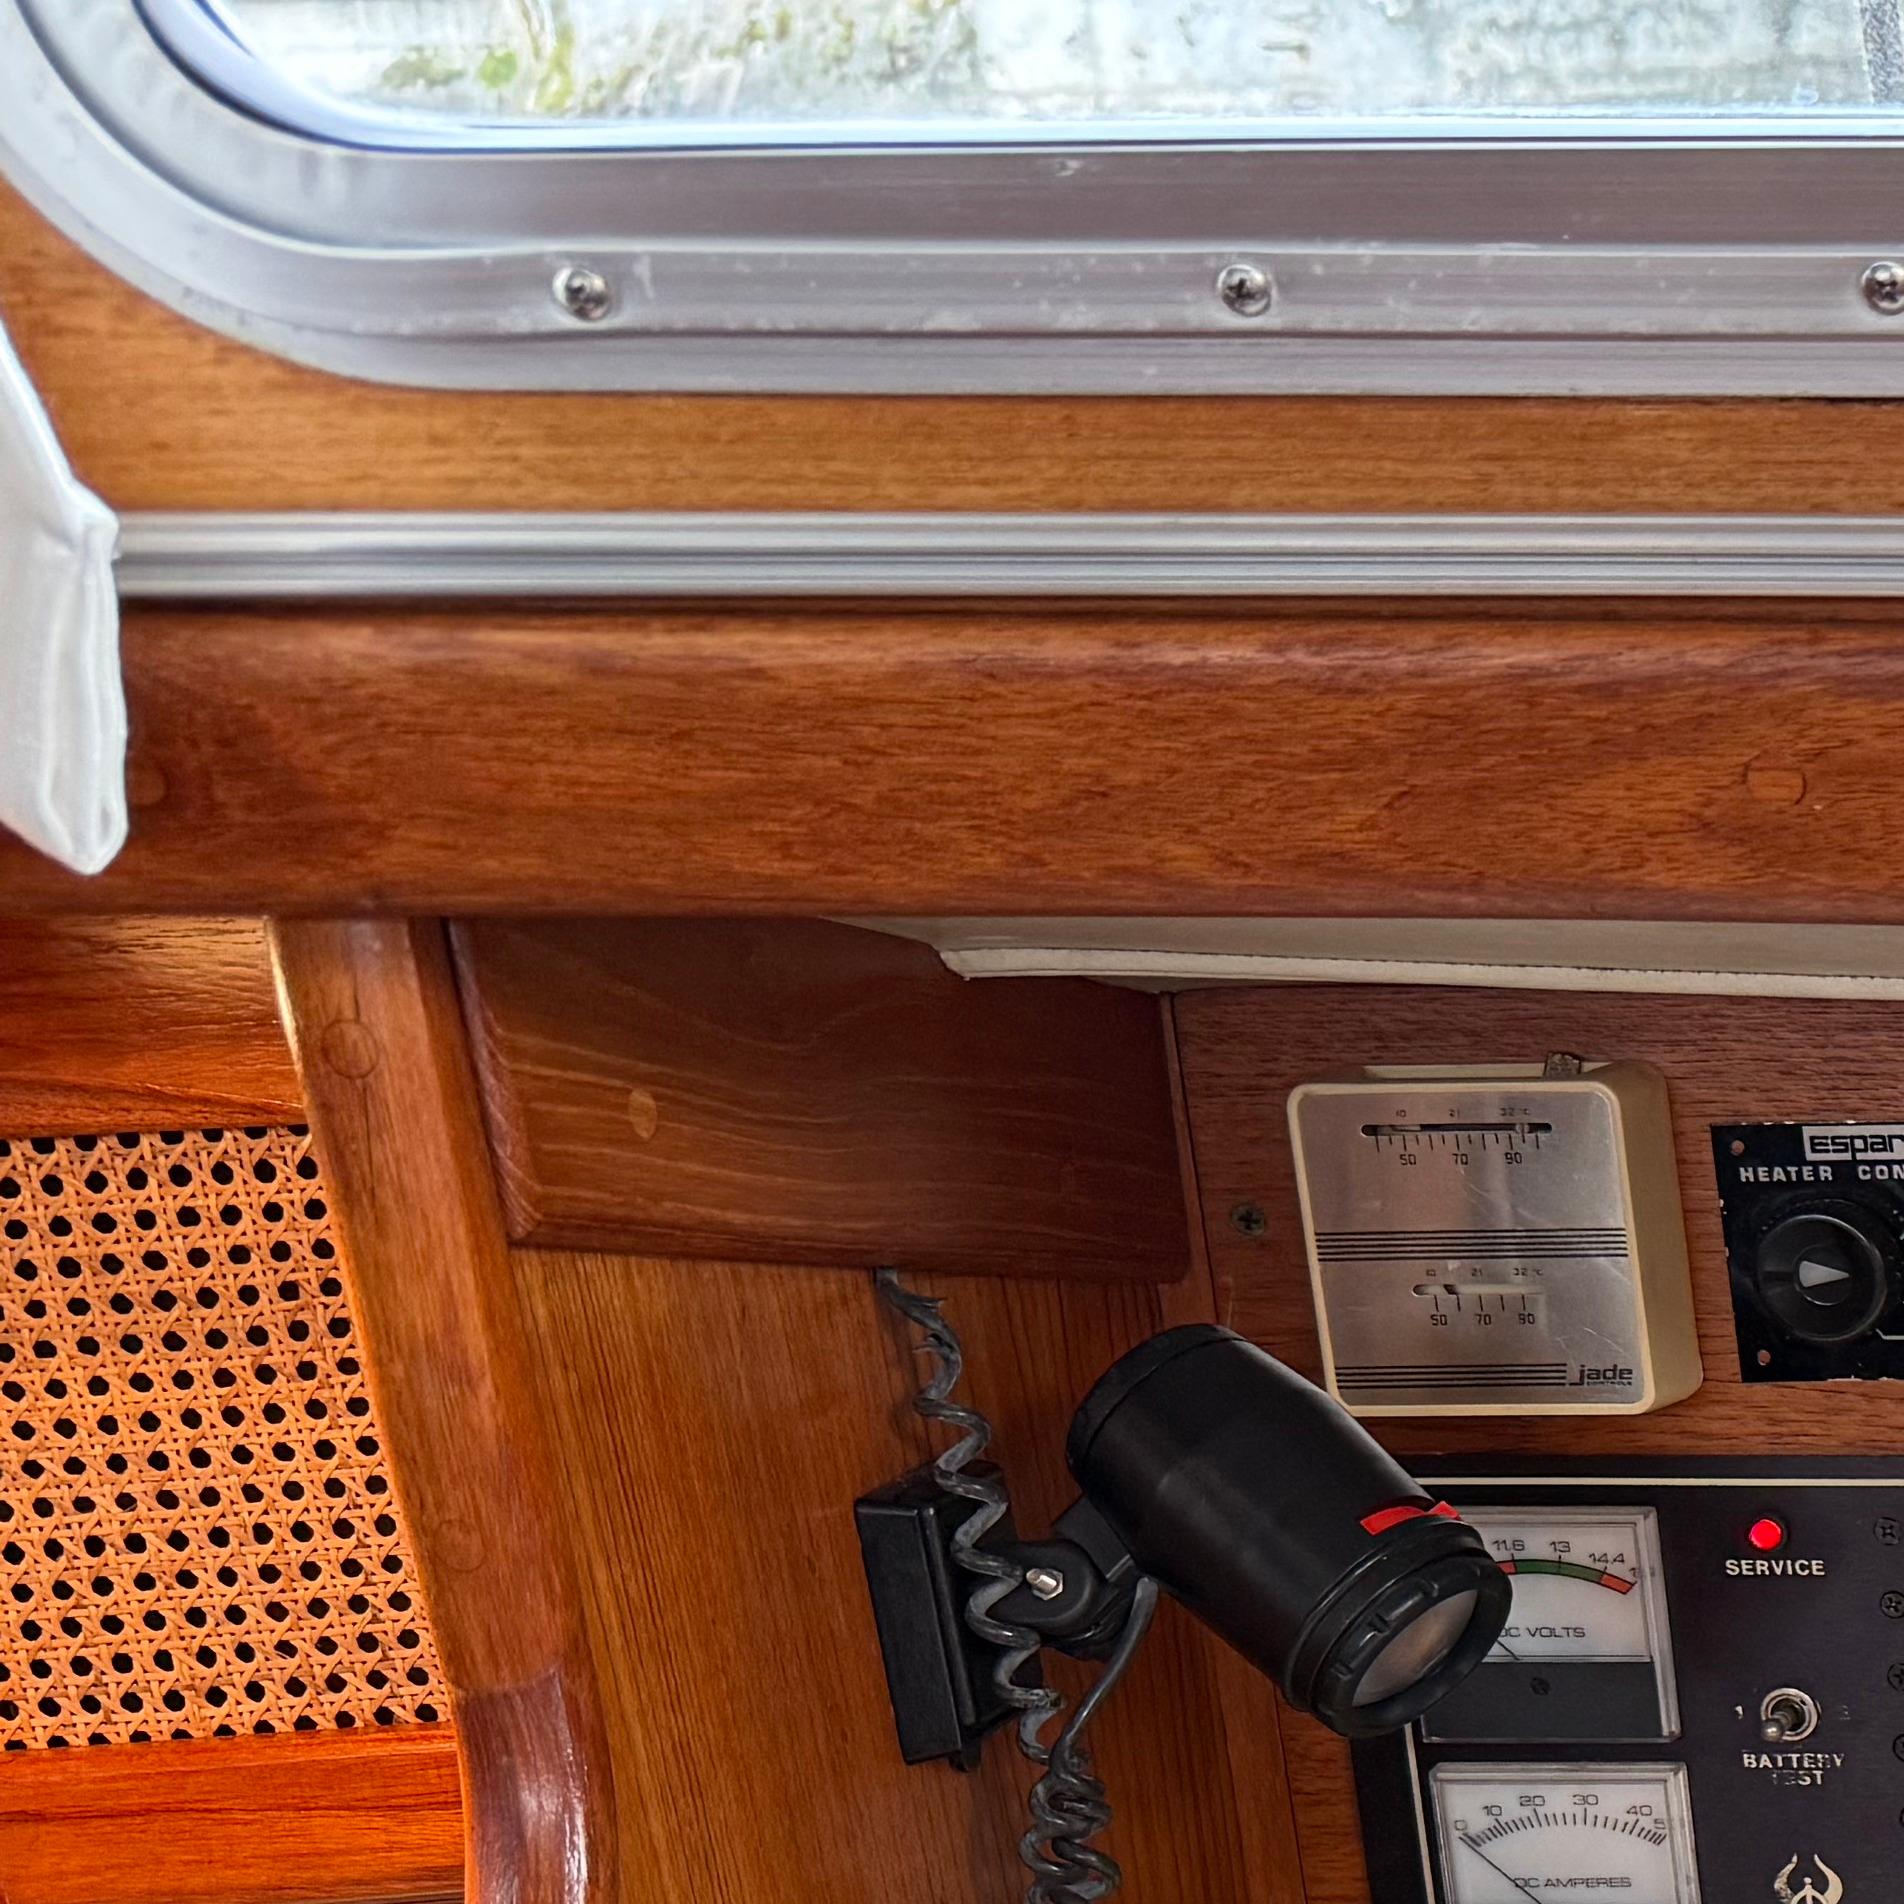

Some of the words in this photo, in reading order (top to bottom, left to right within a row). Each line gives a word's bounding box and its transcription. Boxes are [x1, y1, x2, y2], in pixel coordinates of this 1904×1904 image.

[1400, 1154, 1417, 1166] 50
[1452, 1153, 1468, 1165] 70
[1505, 1152, 1523, 1164] 90
[1740, 1166, 1832, 1182] HEATER
[1431, 1314, 1448, 1326] 50
[1475, 1314, 1491, 1325] 70
[1518, 1313, 1535, 1325] 90
[1550, 1541, 1571, 1553] 13
[1589, 1553, 1625, 1564] 14.4
[1726, 1560, 1825, 1575] SERVICE
[1526, 1627, 1585, 1638] VOLTS
[1743, 1753, 1841, 1768] BATTERY
[1455, 1819, 1467, 1831] 0
[1482, 1805, 1502, 1816] 10
[1519, 1795, 1545, 1807] 20
[1573, 1794, 1598, 1805] 30
[1627, 1805, 1652, 1816] 40
[1514, 1877, 1540, 1888] DC
[1544, 1877, 1631, 1888] AMPERES
